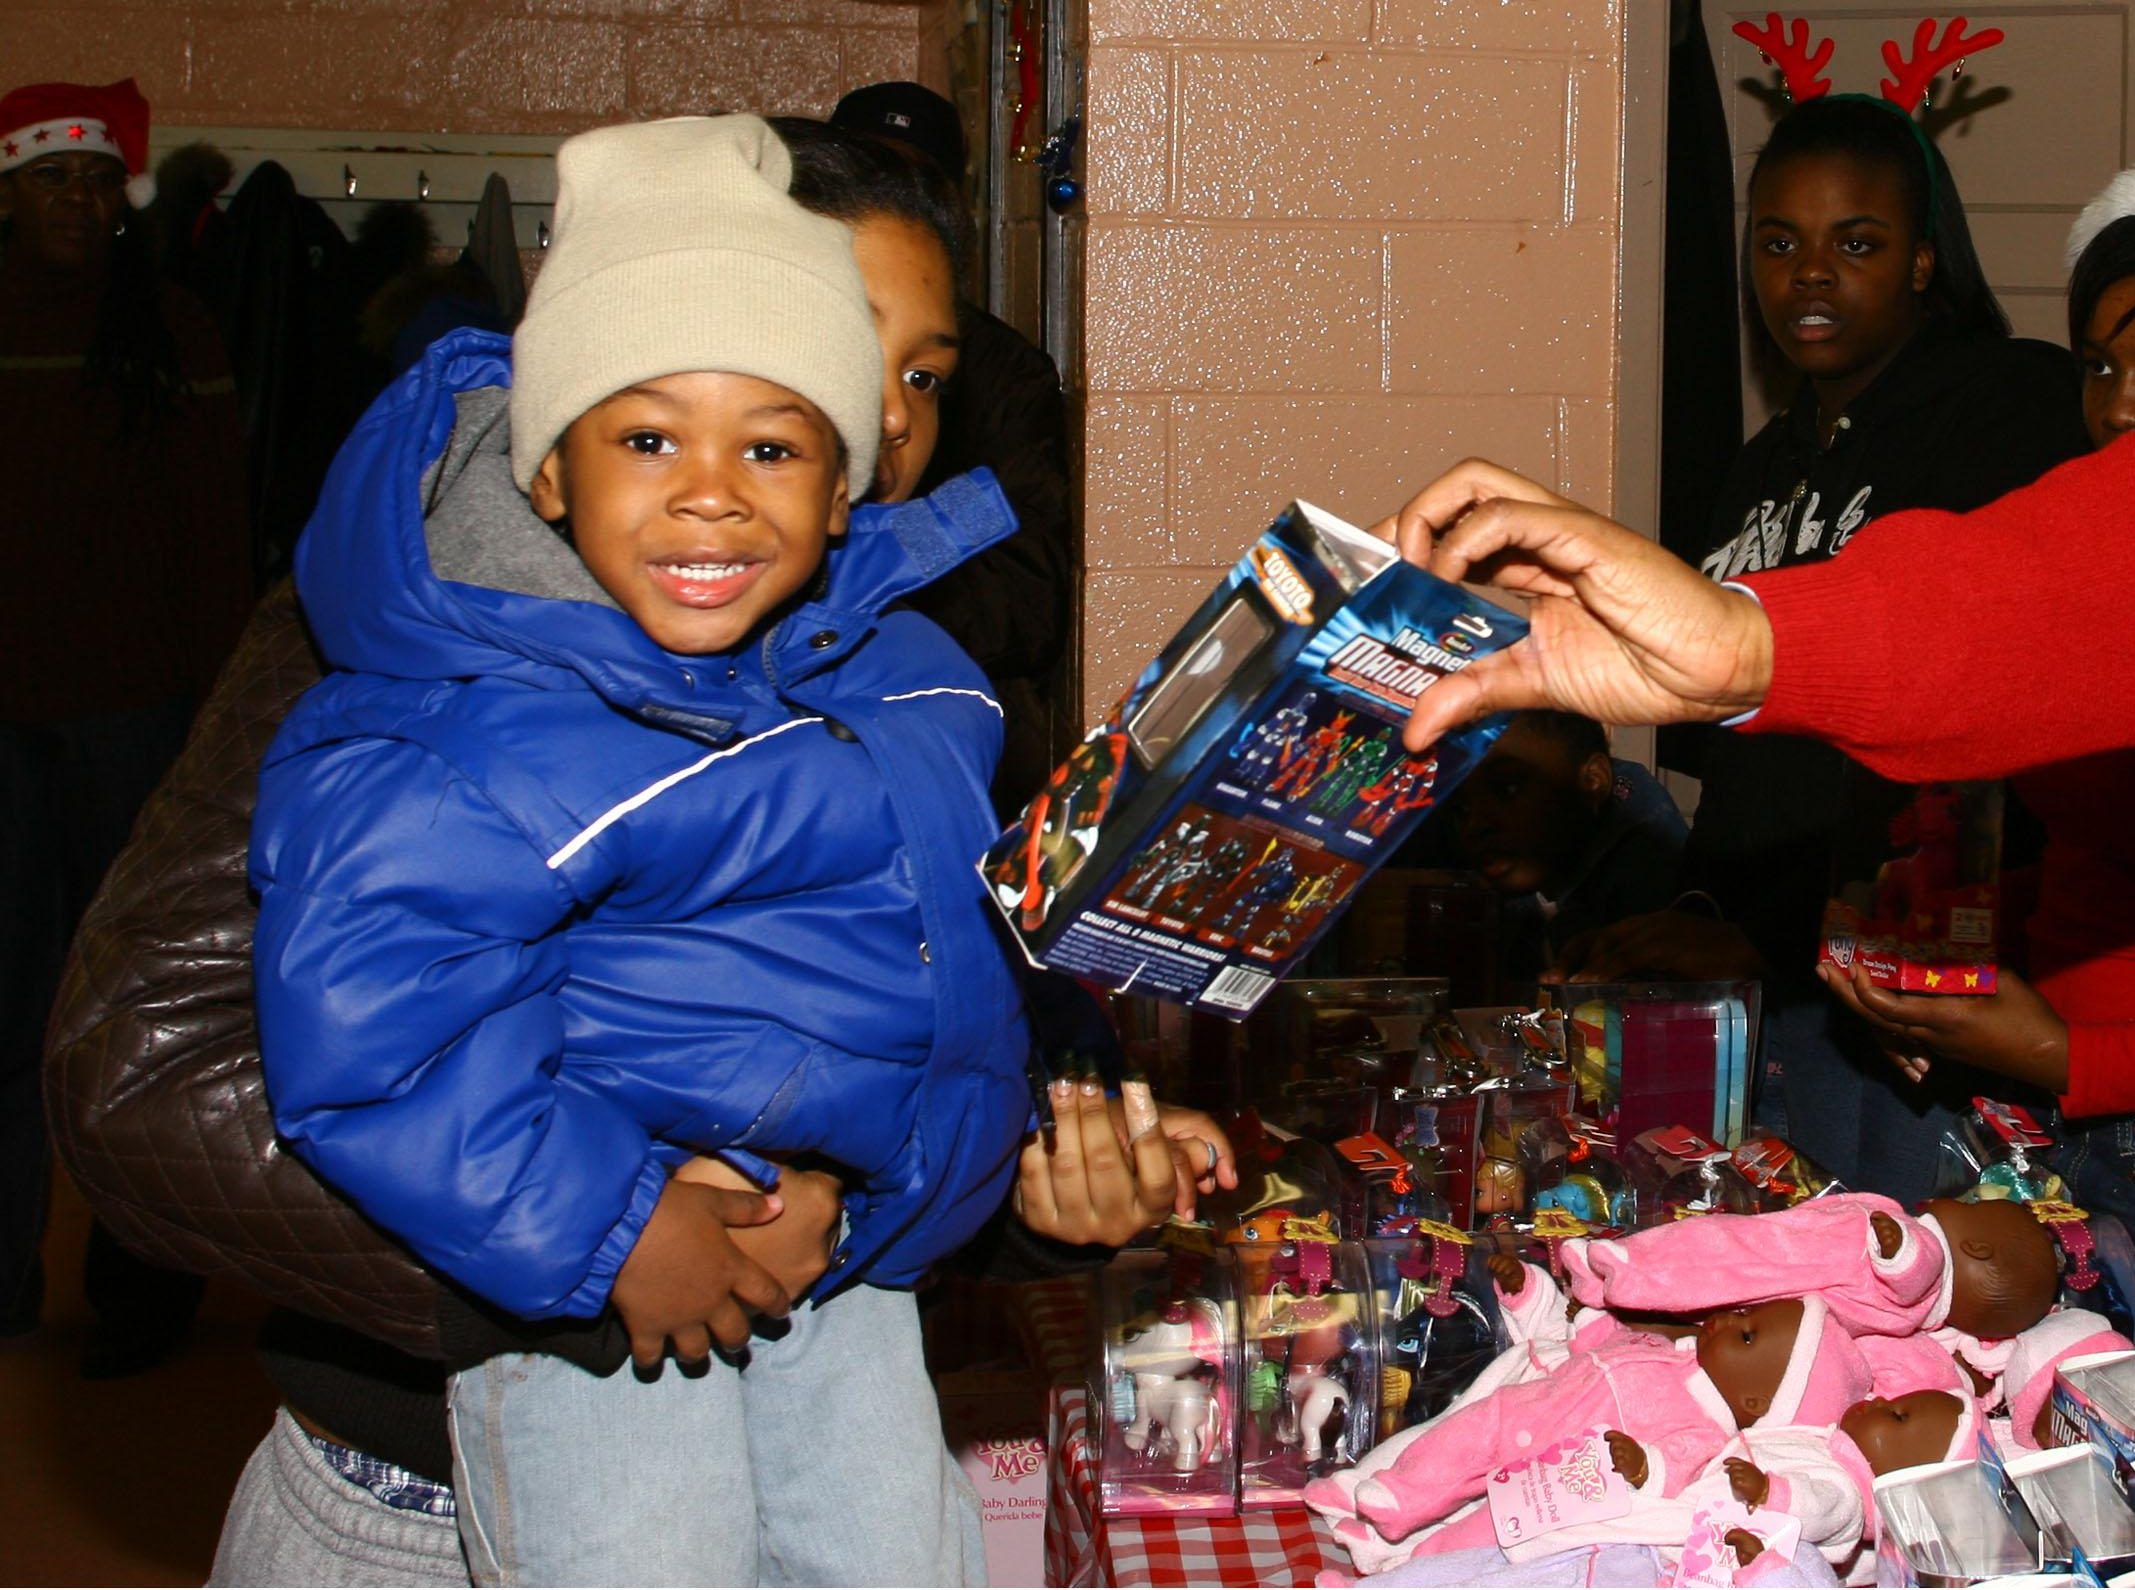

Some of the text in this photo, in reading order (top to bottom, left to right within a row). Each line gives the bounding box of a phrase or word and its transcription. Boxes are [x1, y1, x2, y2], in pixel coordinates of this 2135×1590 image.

[1263, 551, 1312, 610] TOYOTO
[1391, 626, 1473, 672] Magnet
[1080, 911, 1119, 930] COLLECT
[1115, 923, 1133, 935] ALL
[1138, 930, 1183, 949] MAGNETIC
[2065, 1401, 2088, 1436] Mag
[992, 1453, 1038, 1478] Me
[1576, 1442, 1599, 1480] You
[1560, 1465, 1580, 1492] Me
[1008, 1496, 1048, 1510] Darling
[1543, 1482, 1554, 1504] Baby
[984, 1512, 1019, 1522] Querida
[1548, 1504, 1561, 1523] Doll
